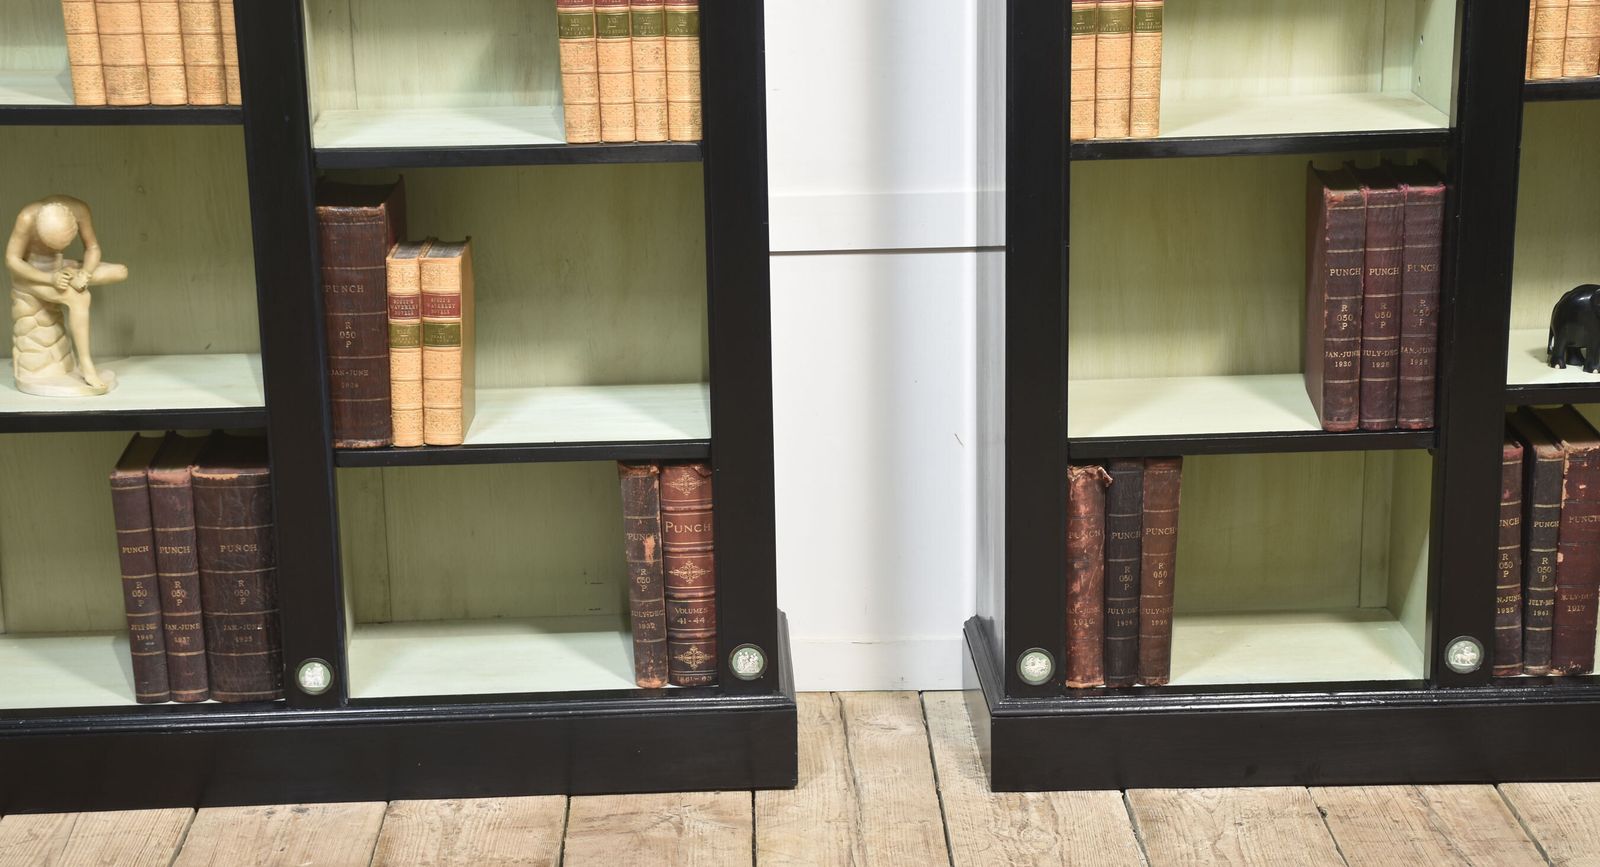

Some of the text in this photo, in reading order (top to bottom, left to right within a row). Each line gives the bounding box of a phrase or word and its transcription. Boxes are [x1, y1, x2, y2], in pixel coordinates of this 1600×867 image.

[1369, 267, 1399, 276] PUNCH
[1407, 264, 1439, 272] PUNCH
[1330, 268, 1361, 277] PUNCH
[324, 284, 364, 293] PUNCH
[1413, 309, 1431, 317] 050
[1336, 314, 1353, 322] 050
[339, 331, 357, 339] 050
[1068, 530, 1101, 539] PUNCH
[1112, 531, 1141, 540] PUNCH
[1145, 527, 1175, 536] PUNCH
[122, 546, 149, 554] PUNCH
[159, 546, 191, 554] PUNCH
[220, 544, 257, 553] PUNCH
[1499, 561, 1514, 569] 050
[1537, 566, 1552, 574] 050
[1153, 571, 1168, 579] 050
[636, 576, 651, 584] 050
[131, 589, 147, 597] 050
[171, 589, 187, 597] 050
[234, 589, 250, 597] 050
[674, 607, 709, 615] VOLUMES
